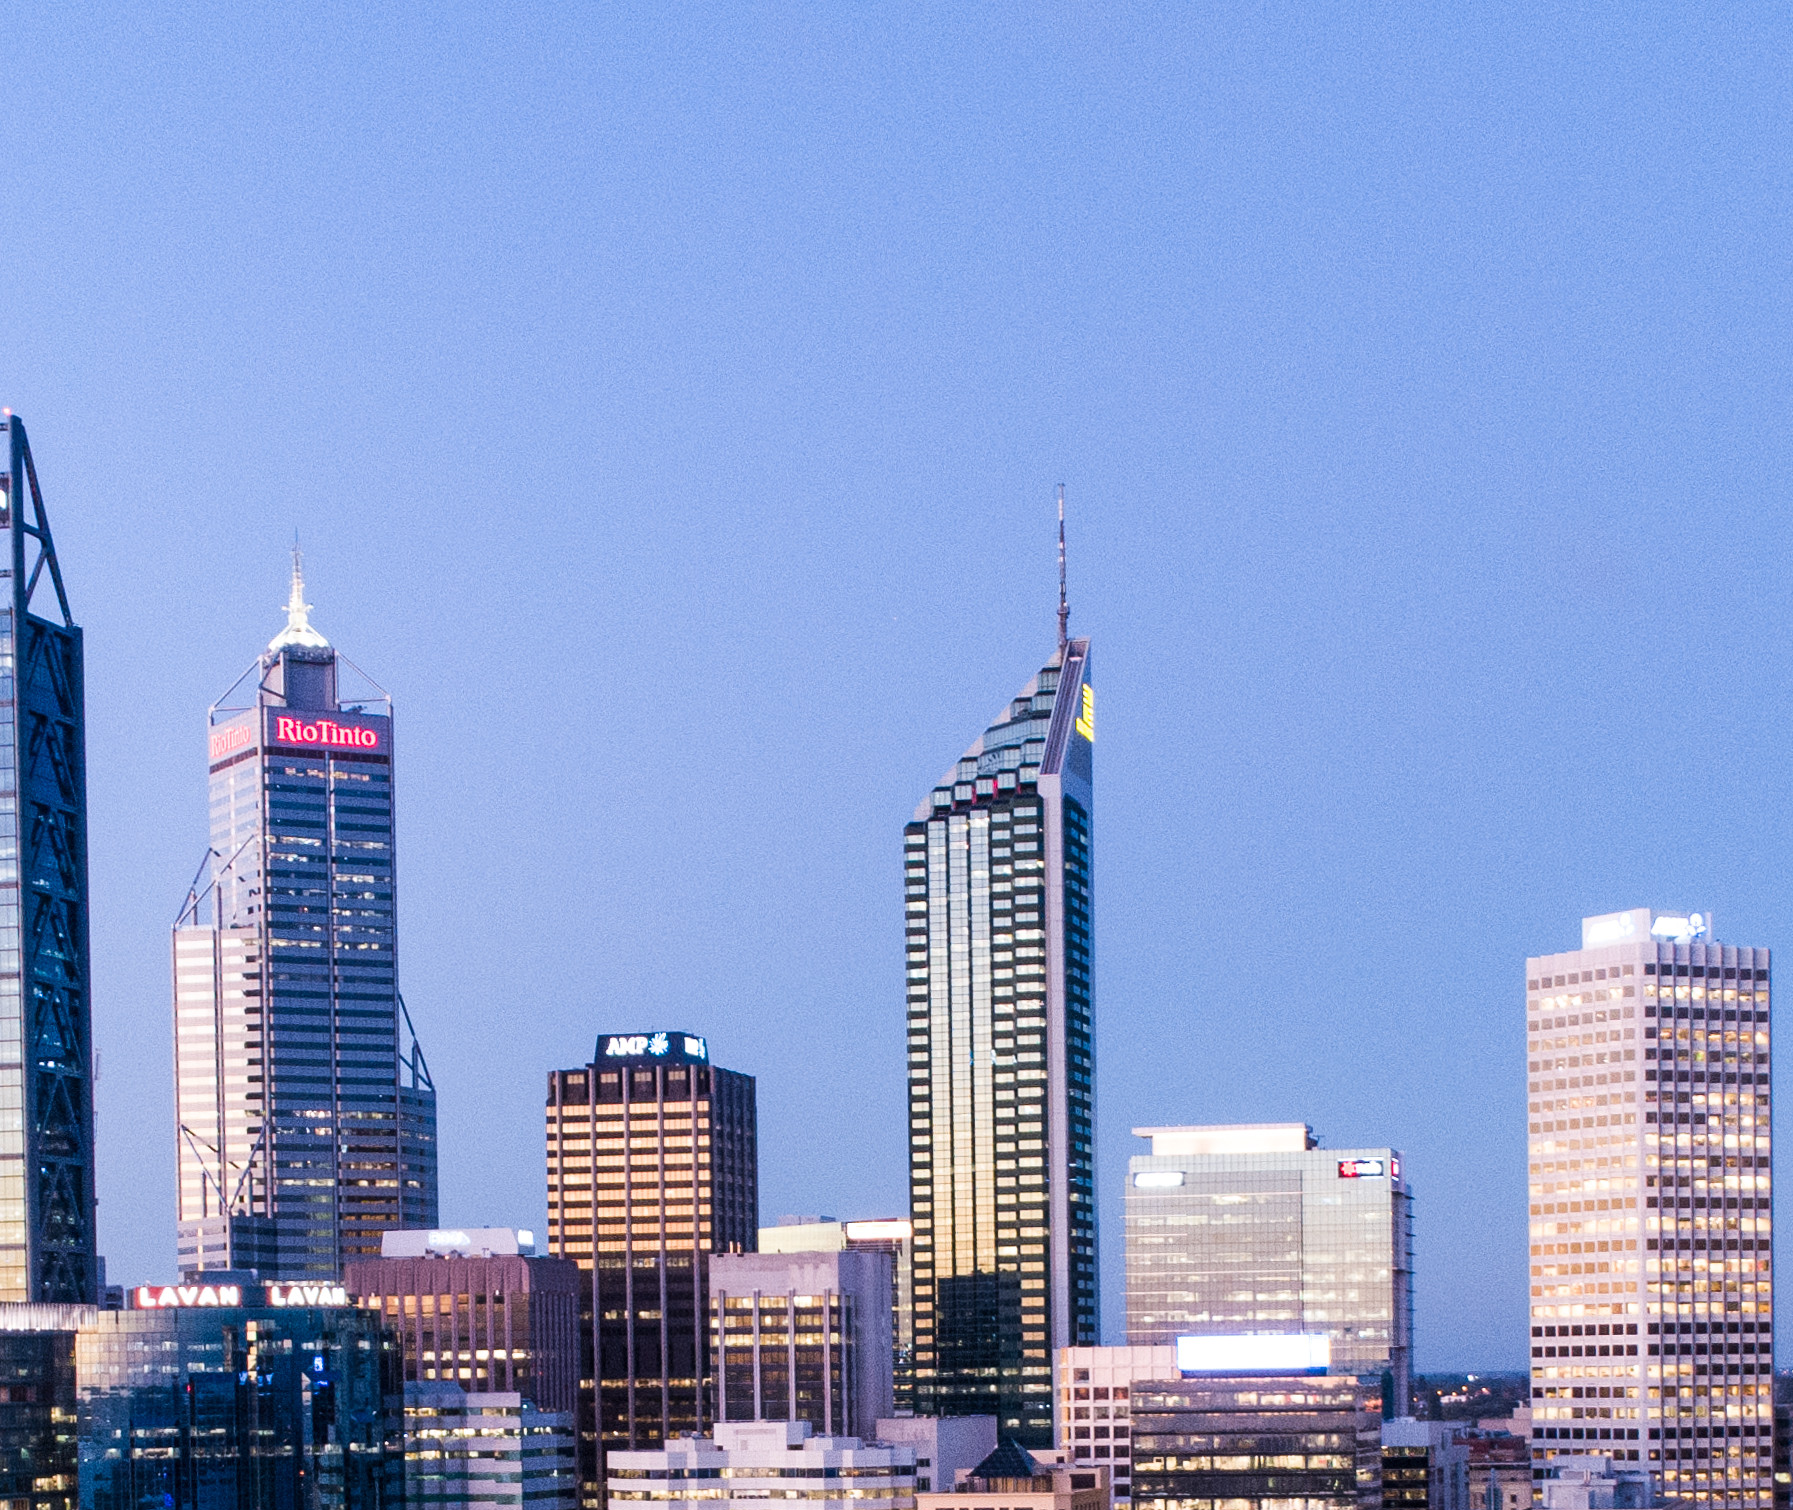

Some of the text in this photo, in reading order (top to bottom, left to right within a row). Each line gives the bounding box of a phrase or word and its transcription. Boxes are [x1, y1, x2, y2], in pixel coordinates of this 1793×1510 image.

[210, 725, 250, 757] RioTinto
[277, 716, 377, 747] RioTinto
[606, 1037, 648, 1056] AMP
[139, 1286, 239, 1306] LAVAN
[270, 1286, 346, 1306] LAVAN
